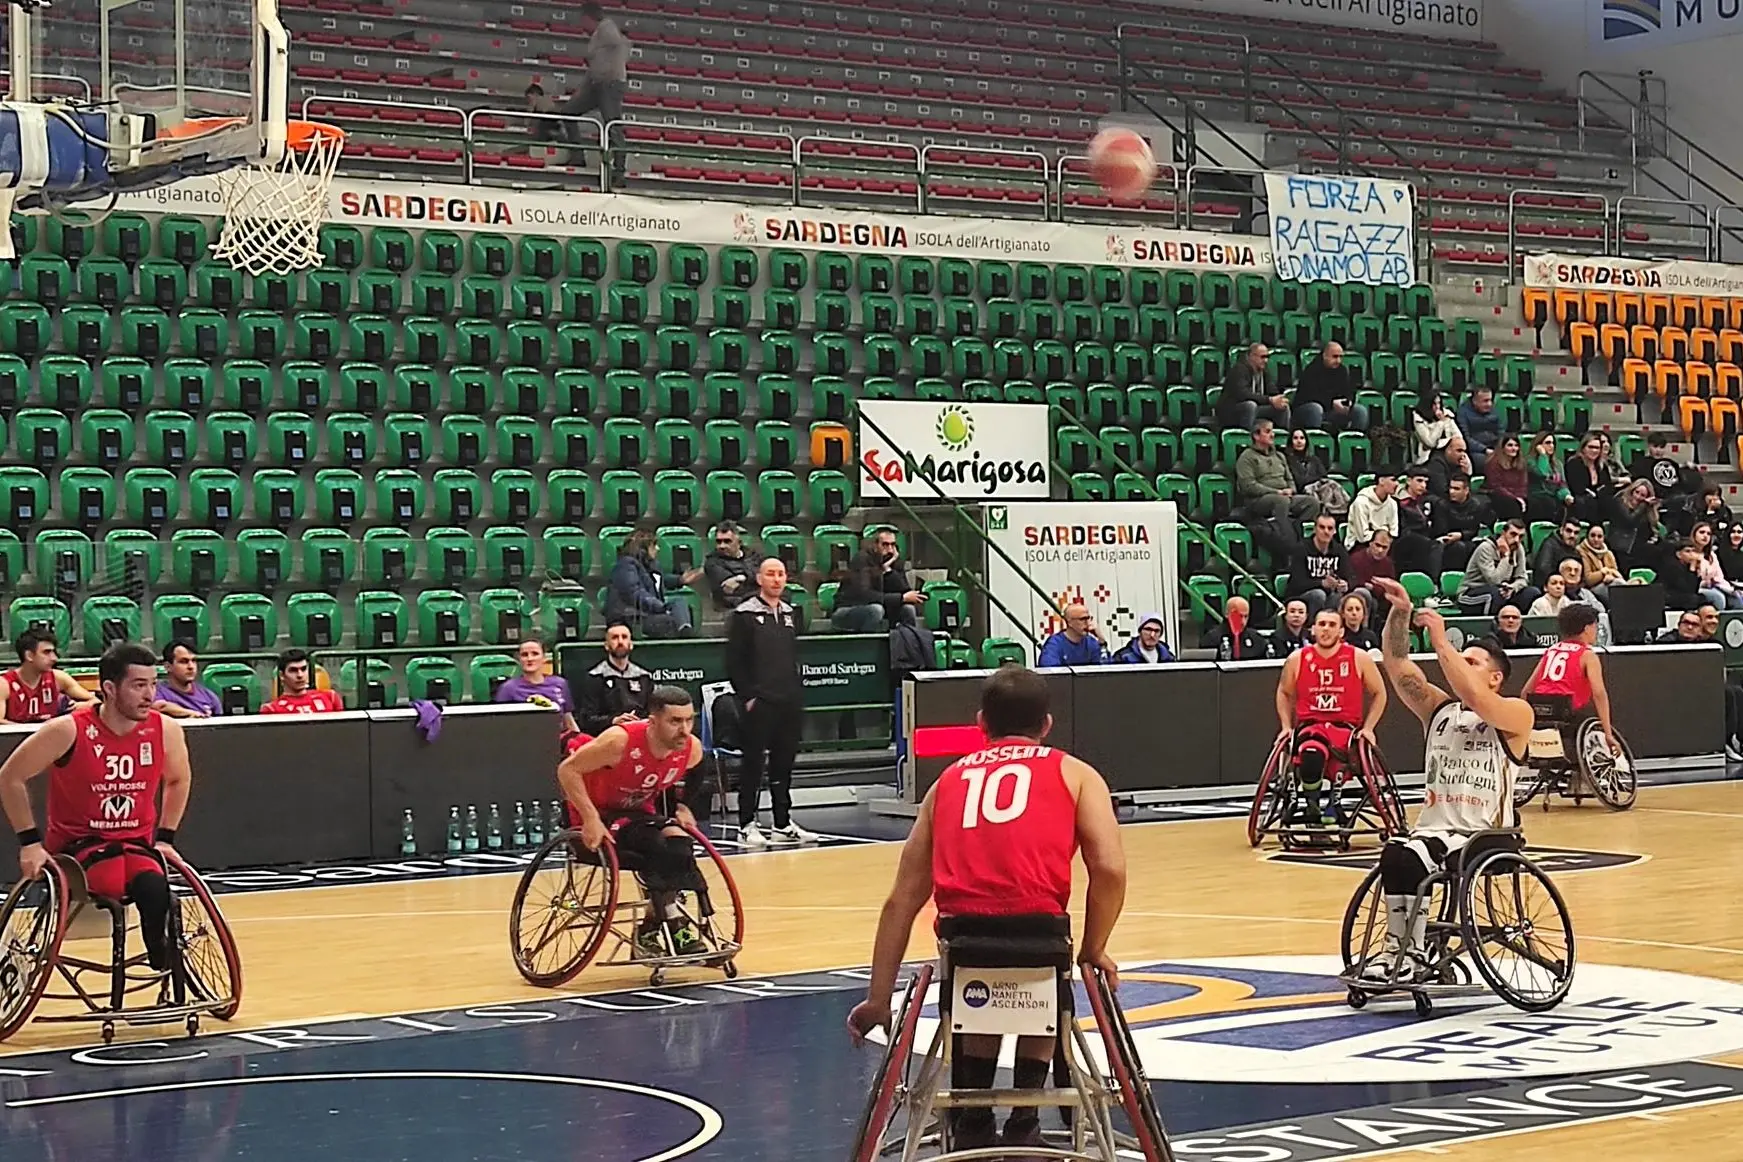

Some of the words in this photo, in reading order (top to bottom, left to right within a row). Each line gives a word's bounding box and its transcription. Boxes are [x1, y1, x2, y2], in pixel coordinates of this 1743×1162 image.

[1288, 177, 1386, 214] FORZA
[341, 191, 513, 225] SARDEGNA
[520, 208, 566, 225] ISOLA
[570, 211, 681, 232] dell'Artigianato
[766, 218, 908, 248] SARDEGNA
[915, 232, 953, 247] ISOLA
[956, 234, 1051, 253] dell'Artigianato
[1133, 239, 1256, 267] SARDEGNA
[1557, 264, 1662, 288] SARDEGNA
[1666, 273, 1692, 287] ISOLA
[1024, 525, 1150, 546] SARDEGNA
[1025, 549, 1060, 562] ISOLA
[1064, 549, 1150, 564] dell'Artigianato
[662, 668, 704, 681] Sardegna
[838, 662, 876, 676] Sardegna
[1542, 650, 1570, 681] 16
[1318, 669, 1334, 686] 15
[1436, 717, 1450, 736] 4
[104, 755, 134, 780] 30
[957, 745, 1052, 768] HOSSEINI
[91, 783, 117, 792] VOLPI
[118, 781, 147, 791] ROSSE
[641, 773, 659, 788] 9
[961, 763, 1032, 829] 10
[90, 819, 139, 829] MENARINI
[965, 987, 988, 999] AMA
[991, 1000, 1049, 1009] ASCENSORI
[1348, 997, 1698, 1064] REALE
[1117, 1073, 1734, 1162] STANCE
